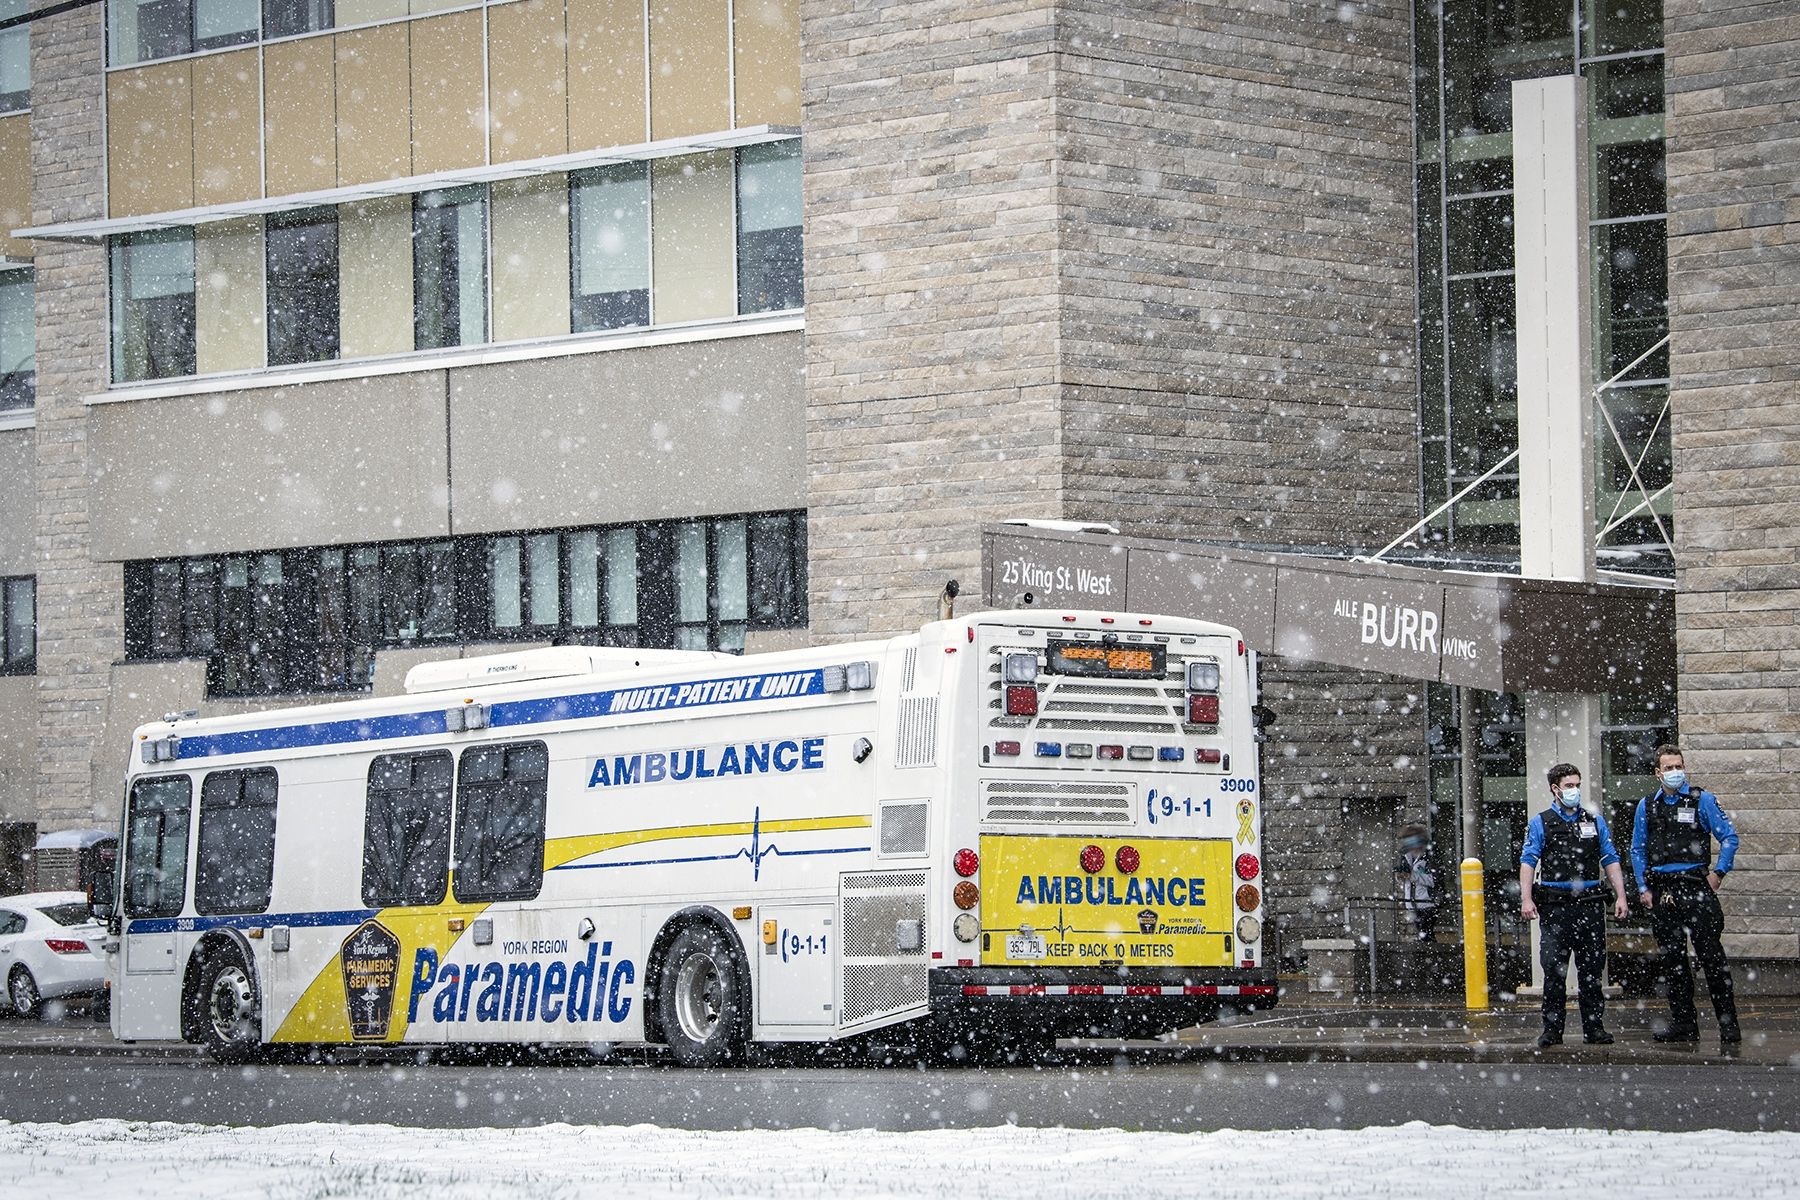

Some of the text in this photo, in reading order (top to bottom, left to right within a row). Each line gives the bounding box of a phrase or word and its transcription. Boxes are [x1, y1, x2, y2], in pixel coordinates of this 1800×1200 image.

[1002, 560, 1112, 595] 25 King St. West
[1333, 599, 1477, 659] AILE BURR WING
[608, 672, 816, 712] MULTI-PATIENT UNIT
[587, 738, 825, 788] AMBULANCE
[1219, 778, 1255, 792] 3900
[1161, 796, 1211, 817] 9-1-1
[1016, 876, 1206, 906] AMBULANCE
[1158, 923, 1206, 935] Paramedic
[367, 943, 388, 958] Region
[503, 940, 568, 955] YORK REGION
[791, 935, 826, 955] 9-1-1
[1046, 943, 1174, 958] KEEP BACK 10 METERS
[346, 959, 394, 974] PARAMEDIC
[350, 974, 391, 989] SERVICES
[407, 941, 635, 1023] Paramedic
